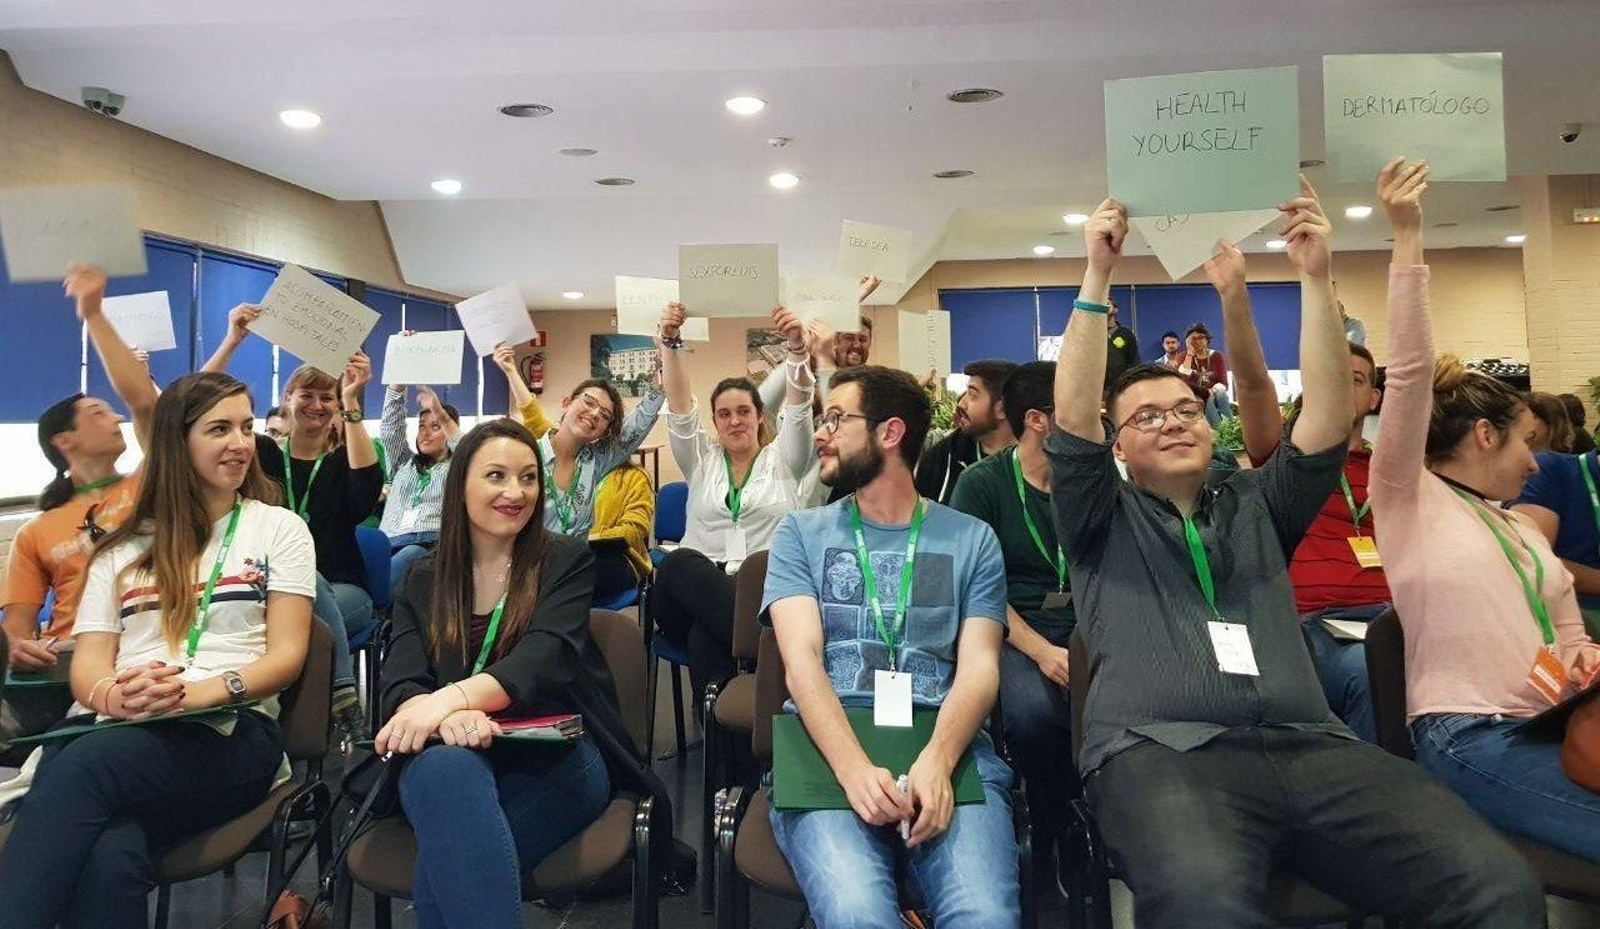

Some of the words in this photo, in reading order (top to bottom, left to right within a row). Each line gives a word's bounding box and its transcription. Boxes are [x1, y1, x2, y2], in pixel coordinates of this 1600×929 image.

[1156, 90, 1246, 120] HEALTH
[1343, 90, 1490, 118] DERMATÓLOGO
[1132, 126, 1264, 156] YOURSELF
